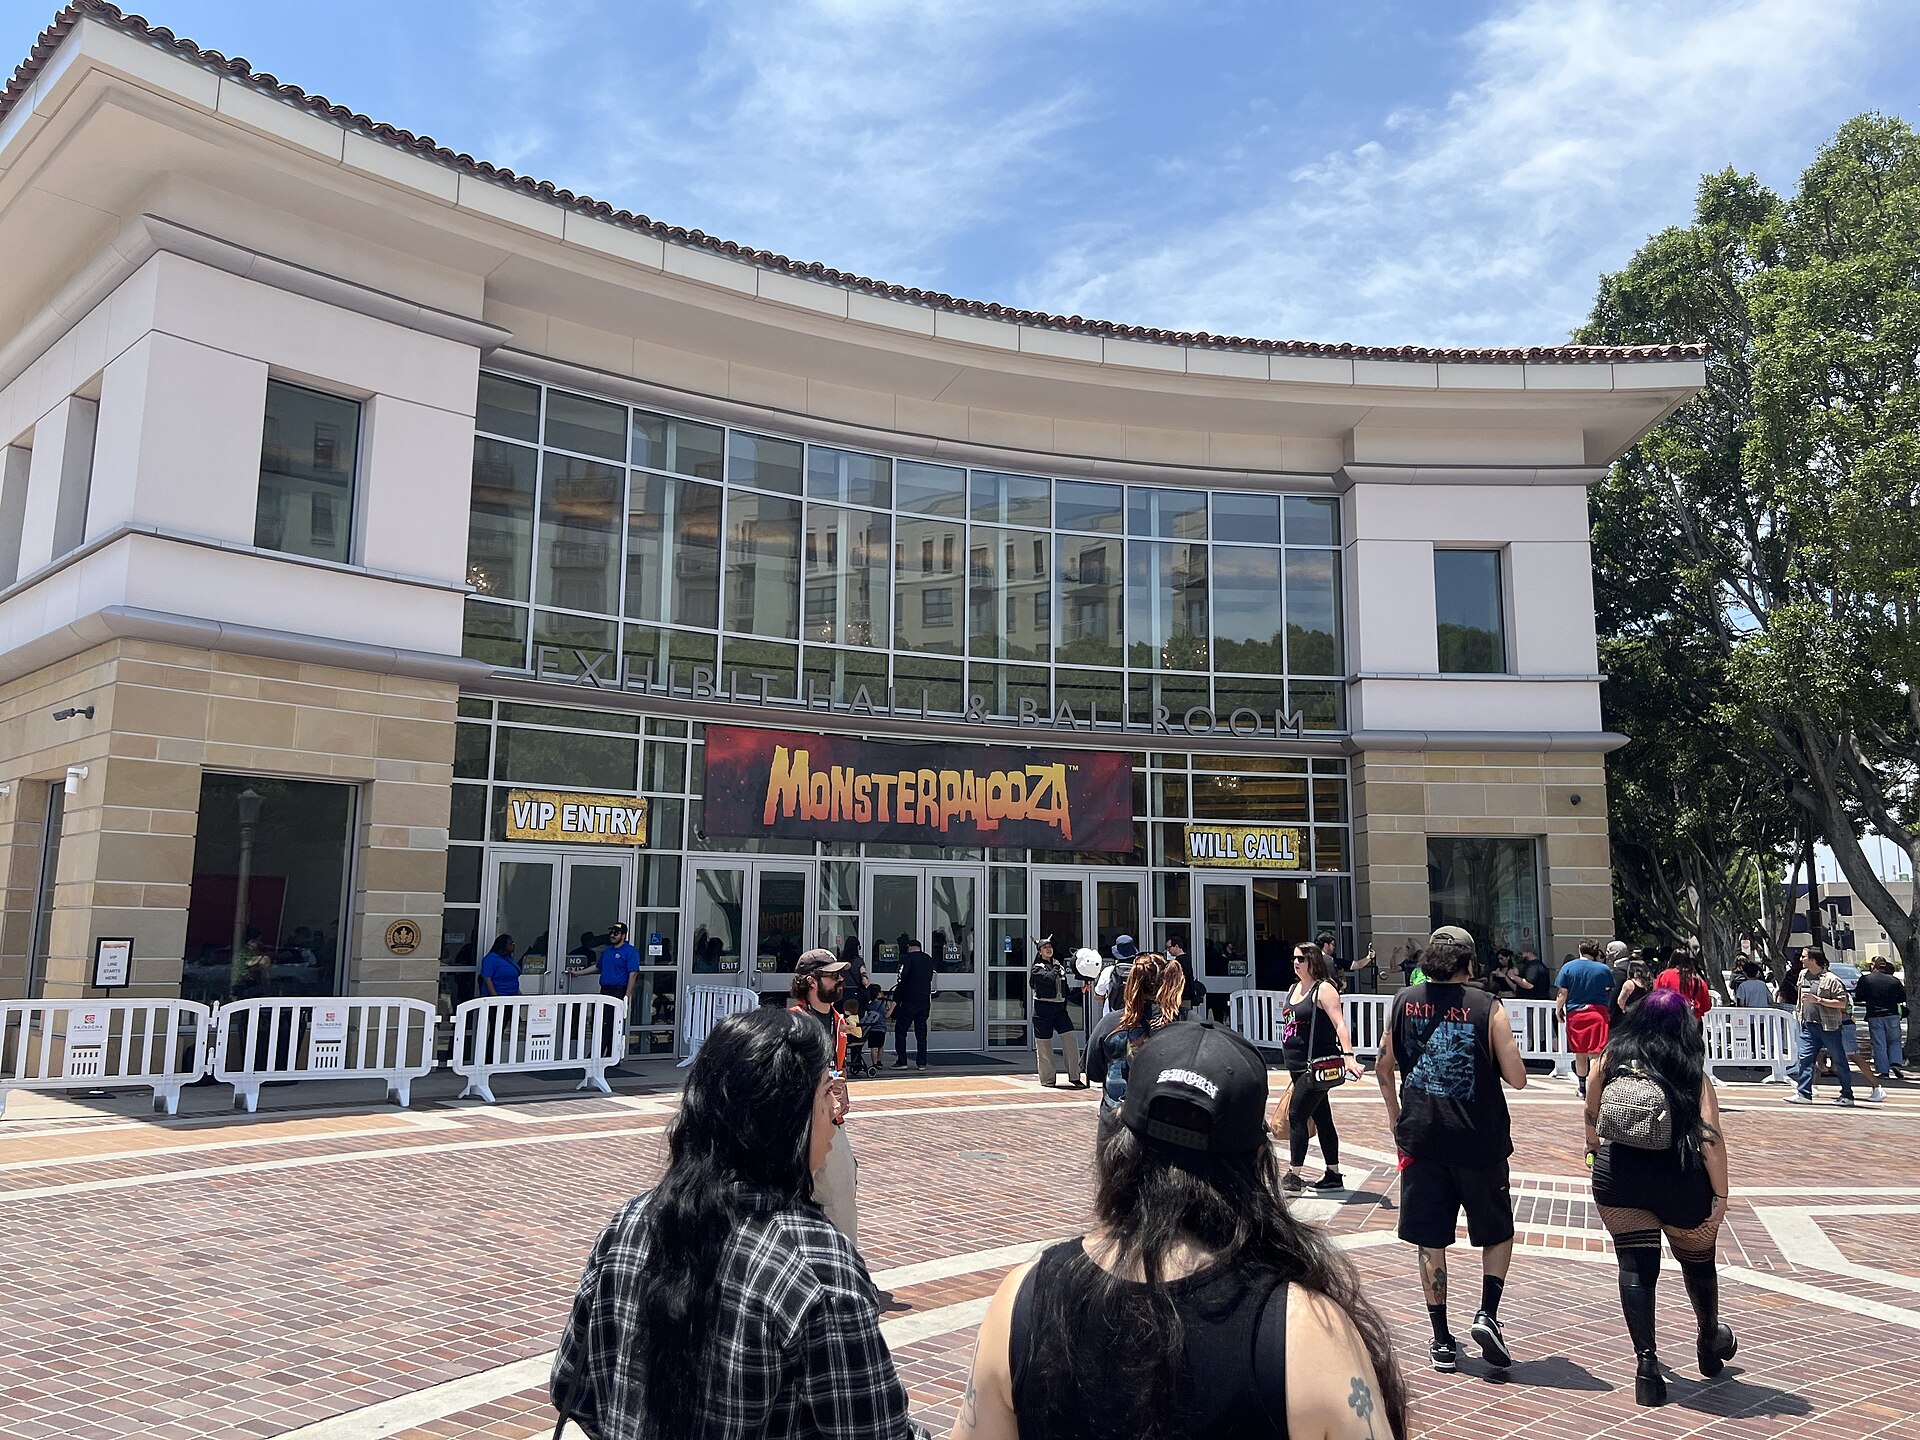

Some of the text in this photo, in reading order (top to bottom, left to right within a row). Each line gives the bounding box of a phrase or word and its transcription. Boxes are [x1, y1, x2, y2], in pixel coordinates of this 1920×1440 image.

[536, 645, 1304, 738] EXHIBIT HALL & BALLROOM
[763, 744, 1072, 841] MONSTERPALOOZA
[511, 799, 643, 835] VIP ENTRY
[1189, 832, 1295, 860] WILL CALL
[721, 962, 739, 970] EXIT
